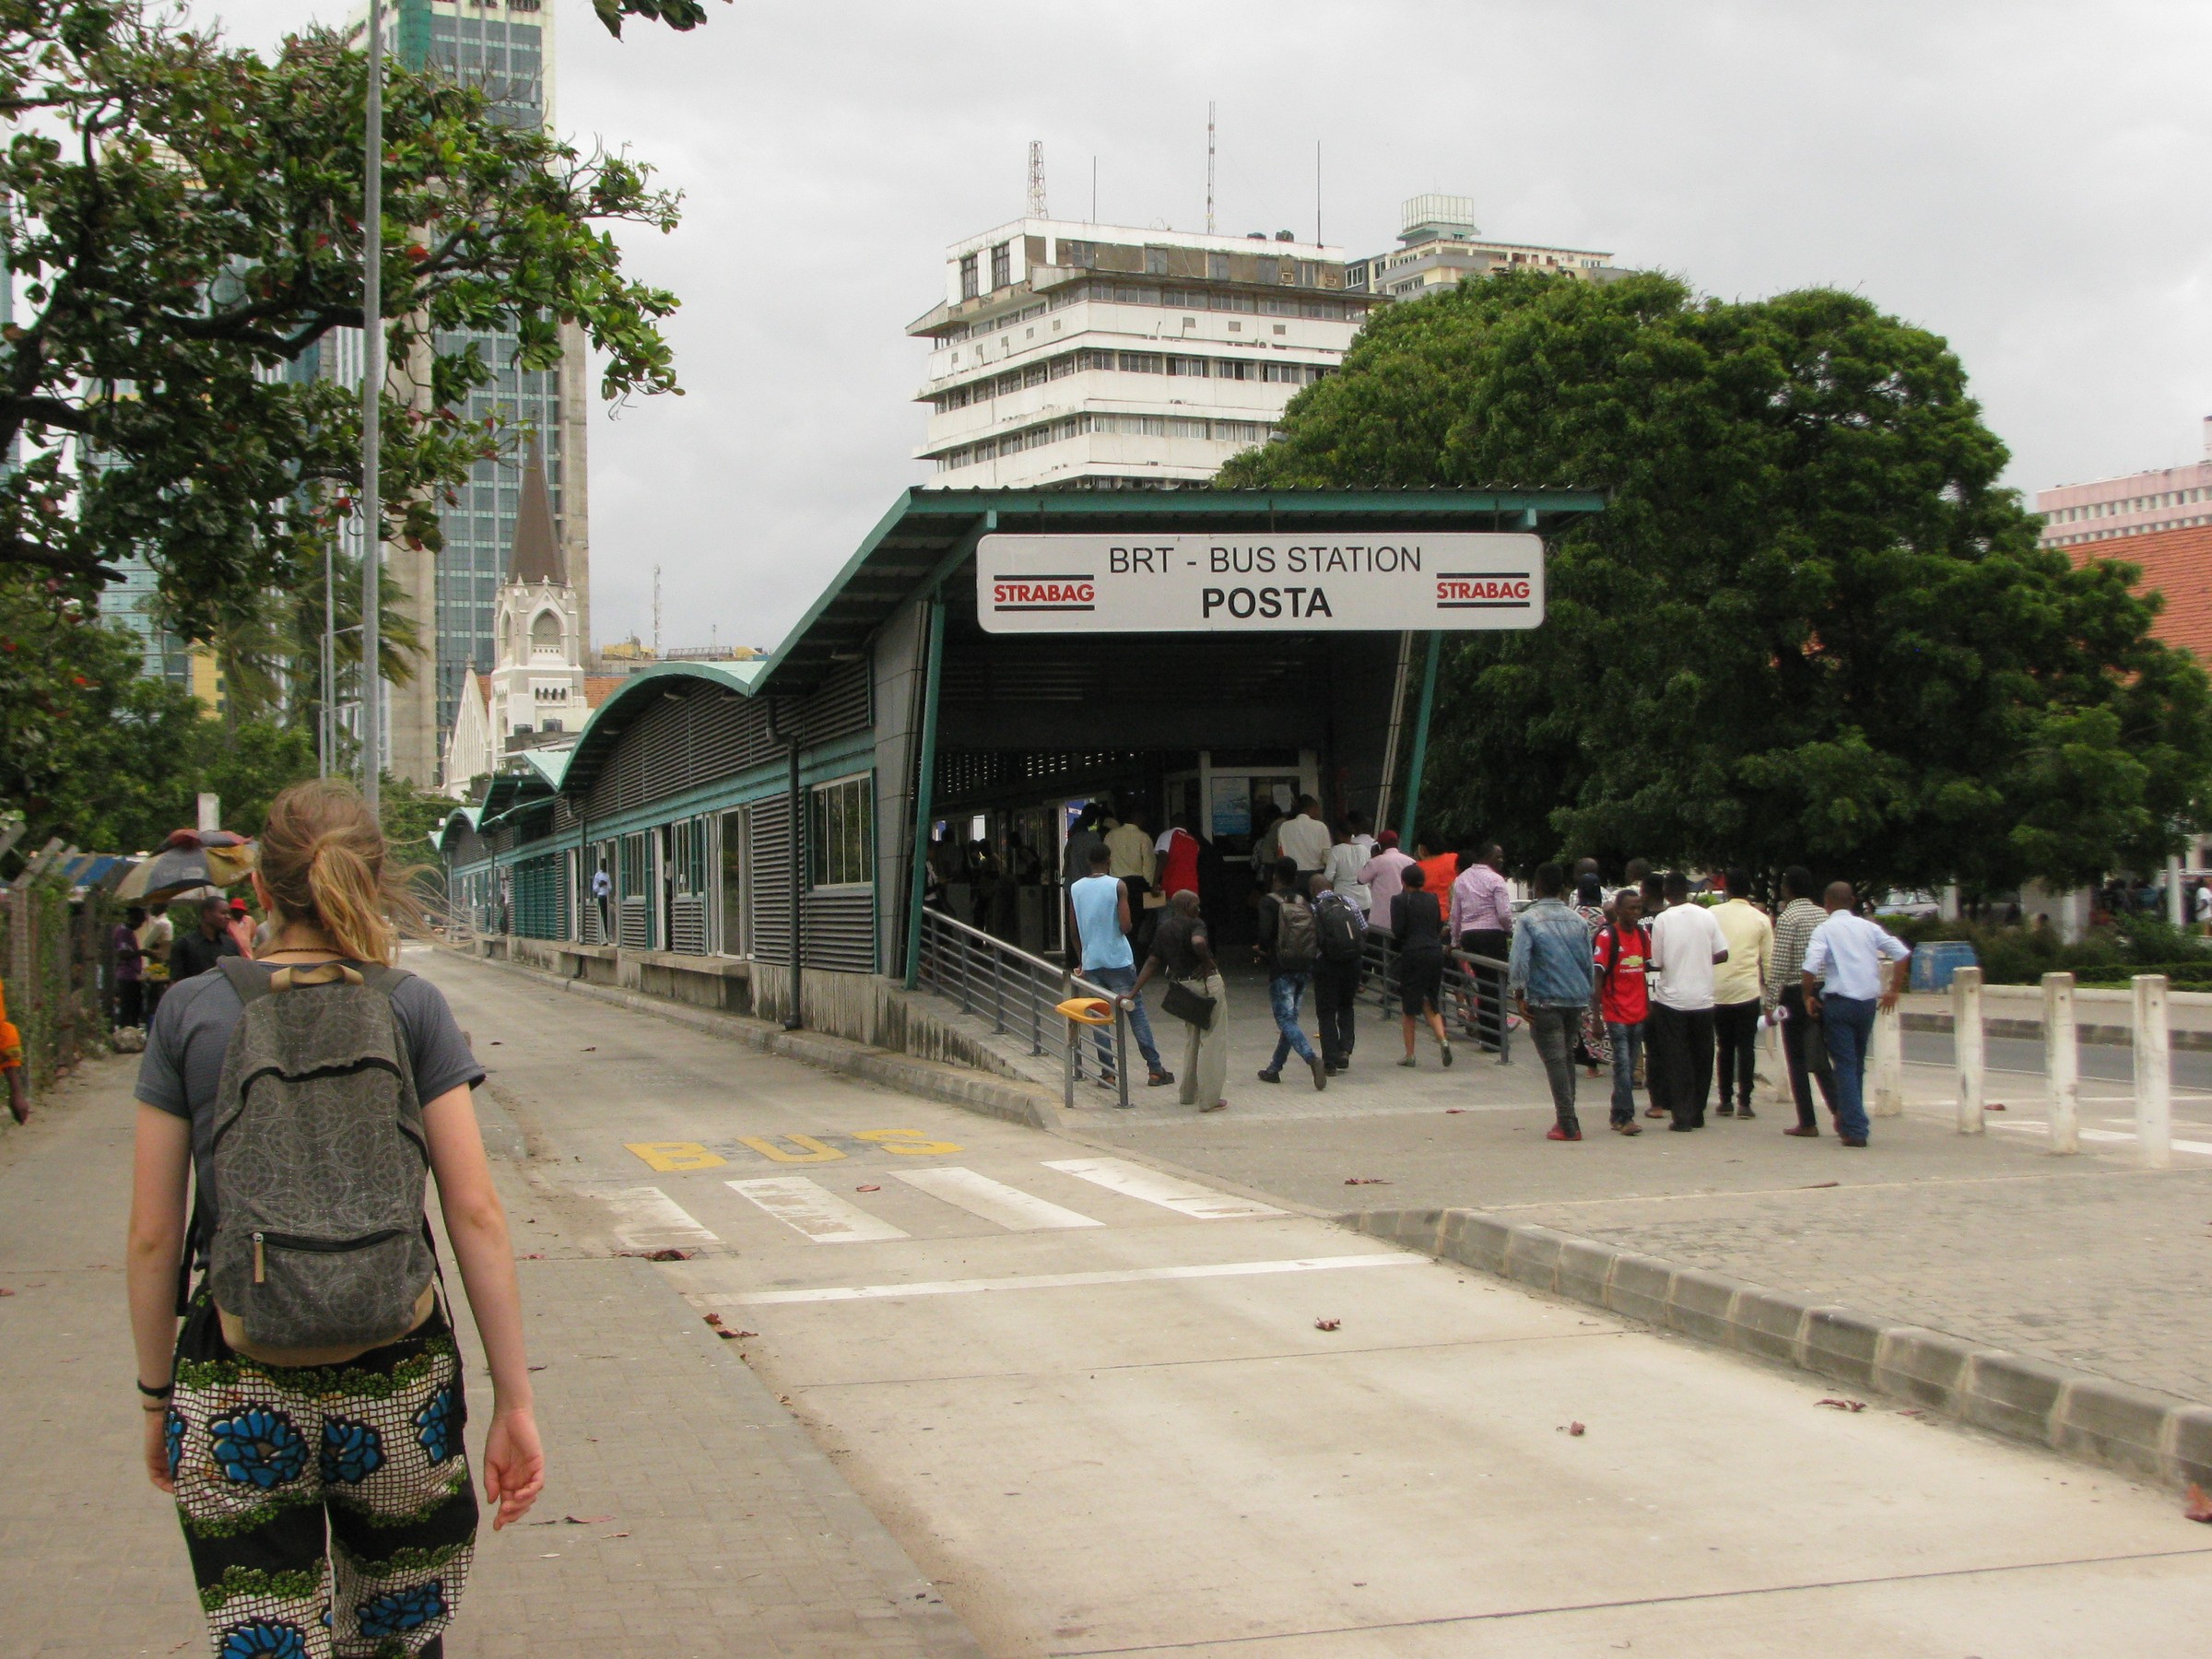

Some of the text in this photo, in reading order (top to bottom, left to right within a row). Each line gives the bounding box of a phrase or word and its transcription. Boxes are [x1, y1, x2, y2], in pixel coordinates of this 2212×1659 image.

[1110, 547, 1175, 573] BRT
[1210, 547, 1276, 573] BUS
[1288, 546, 1421, 573] STATION
[994, 584, 1095, 602] STRABAG
[1202, 587, 1333, 618] POSTA
[1437, 582, 1530, 599] STRABAG
[622, 1129, 966, 1171] BUS
